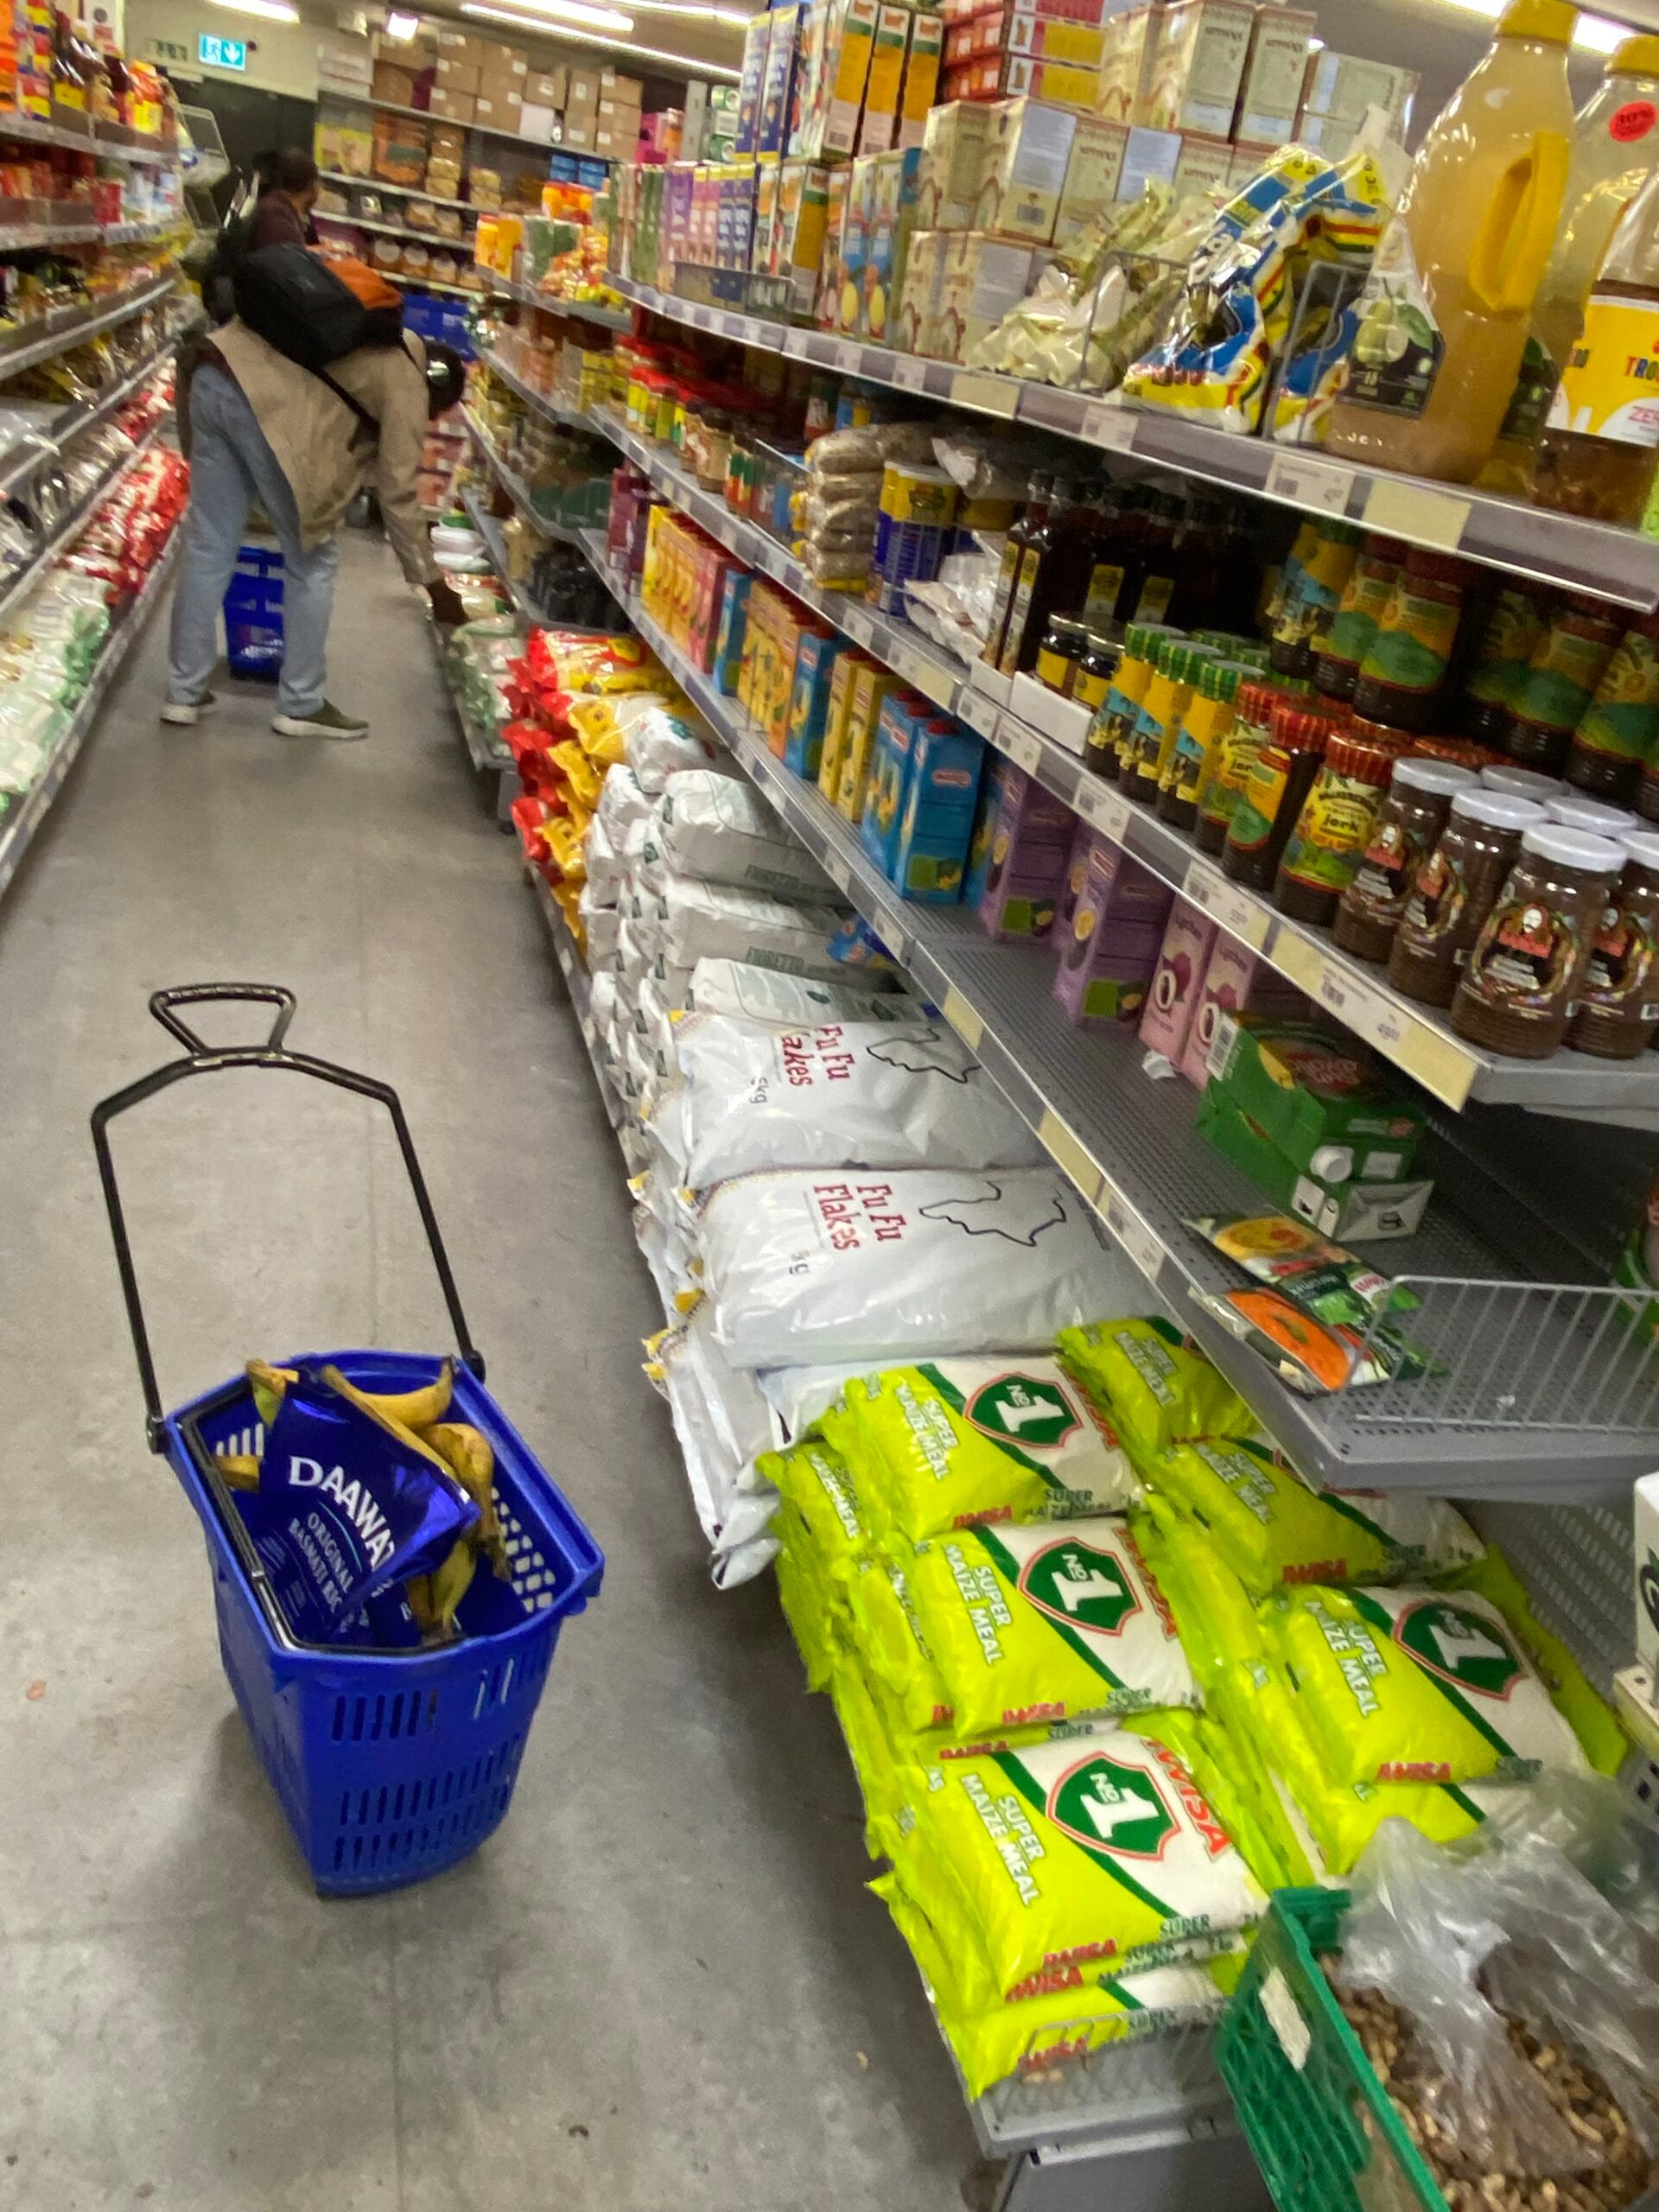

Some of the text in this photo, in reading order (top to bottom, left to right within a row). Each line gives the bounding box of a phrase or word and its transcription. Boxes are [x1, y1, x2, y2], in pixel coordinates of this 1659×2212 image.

[781, 1036, 815, 1086] akes
[822, 1052, 855, 1080] Fu
[813, 1184, 862, 1250] Flakes
[856, 1184, 906, 1241] Fu Fu
[995, 1395, 1065, 1433] 1
[918, 1434, 950, 1480] MEAL
[946, 1544, 1004, 1664] MAIZE MEAL
[975, 1566, 1012, 1626] SUPER
[1052, 1569, 1122, 1612] 1
[1338, 1658, 1380, 1718] MEAL
[961, 1774, 1008, 1839] MAIZE
[998, 1842, 1041, 1906] MEAL
[999, 1796, 1045, 1862] SUPER
[1080, 1787, 1160, 1839] 1
